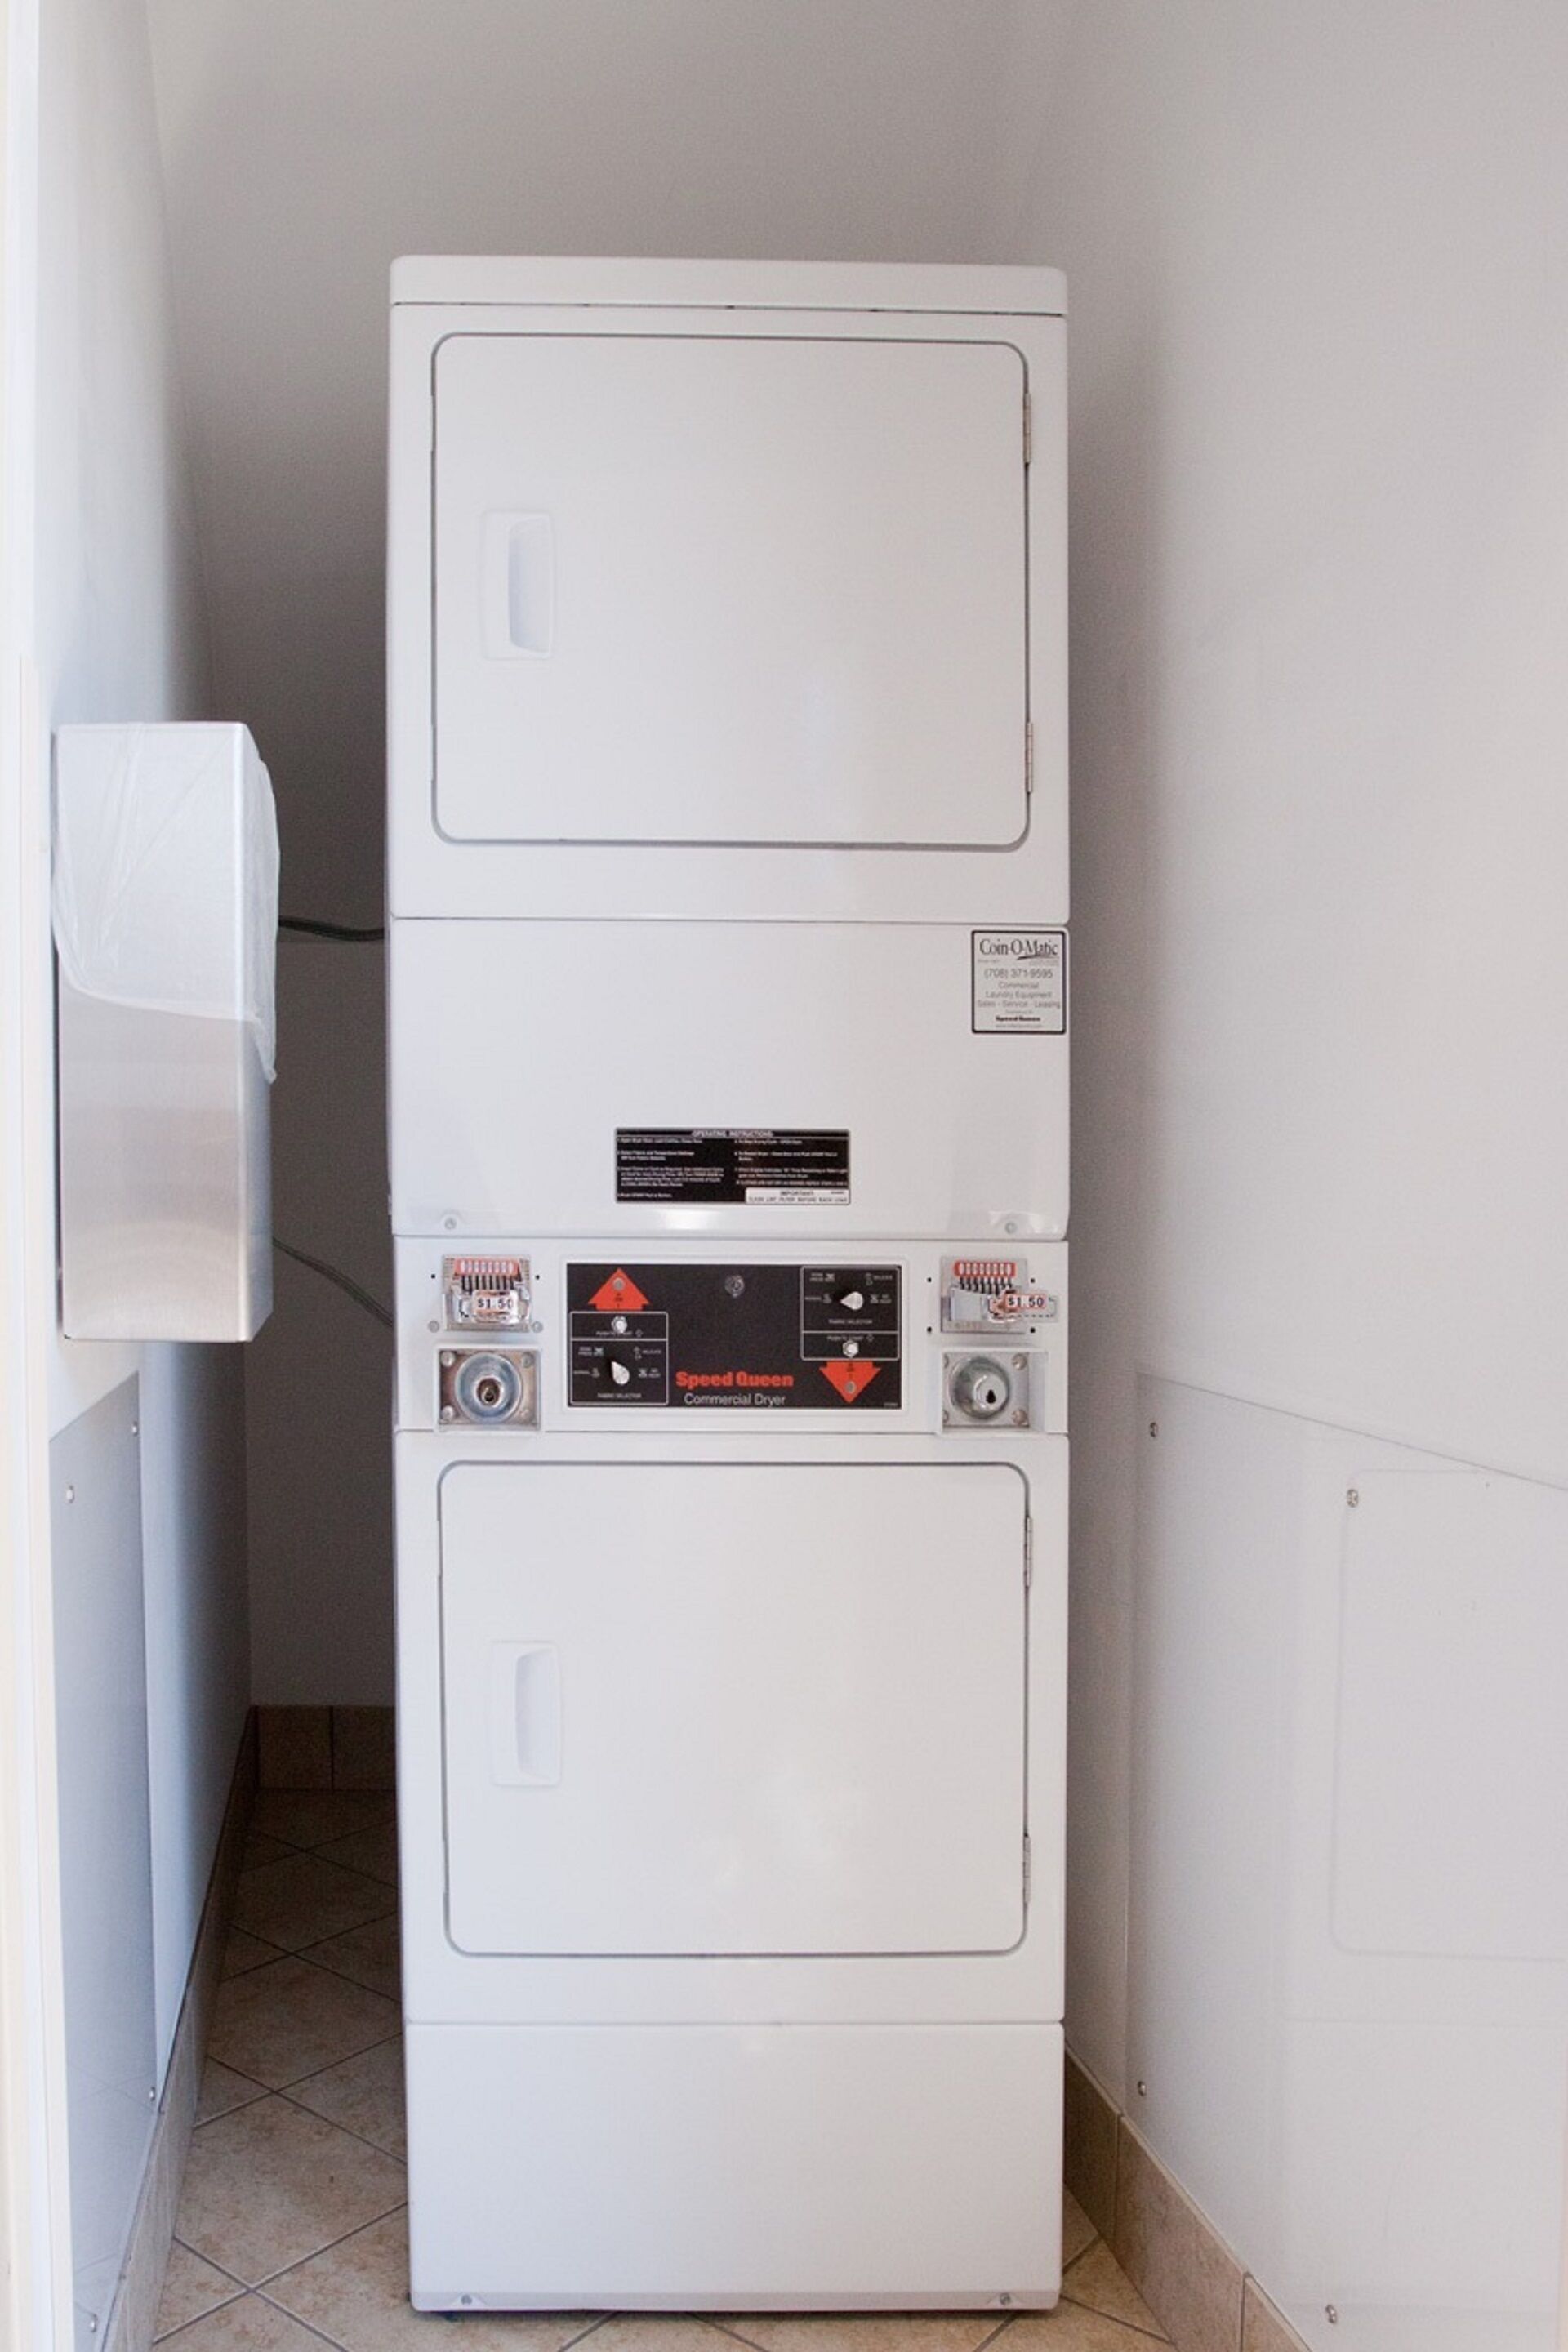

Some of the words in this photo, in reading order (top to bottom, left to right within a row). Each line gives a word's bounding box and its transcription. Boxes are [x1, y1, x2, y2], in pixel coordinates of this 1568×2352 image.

[1009, 1297, 1045, 1307] $1.50
[676, 1371, 733, 1390] Speed
[736, 1371, 794, 1387] Queen
[684, 1392, 751, 1405] Commercial
[754, 1392, 786, 1406] Dryer
